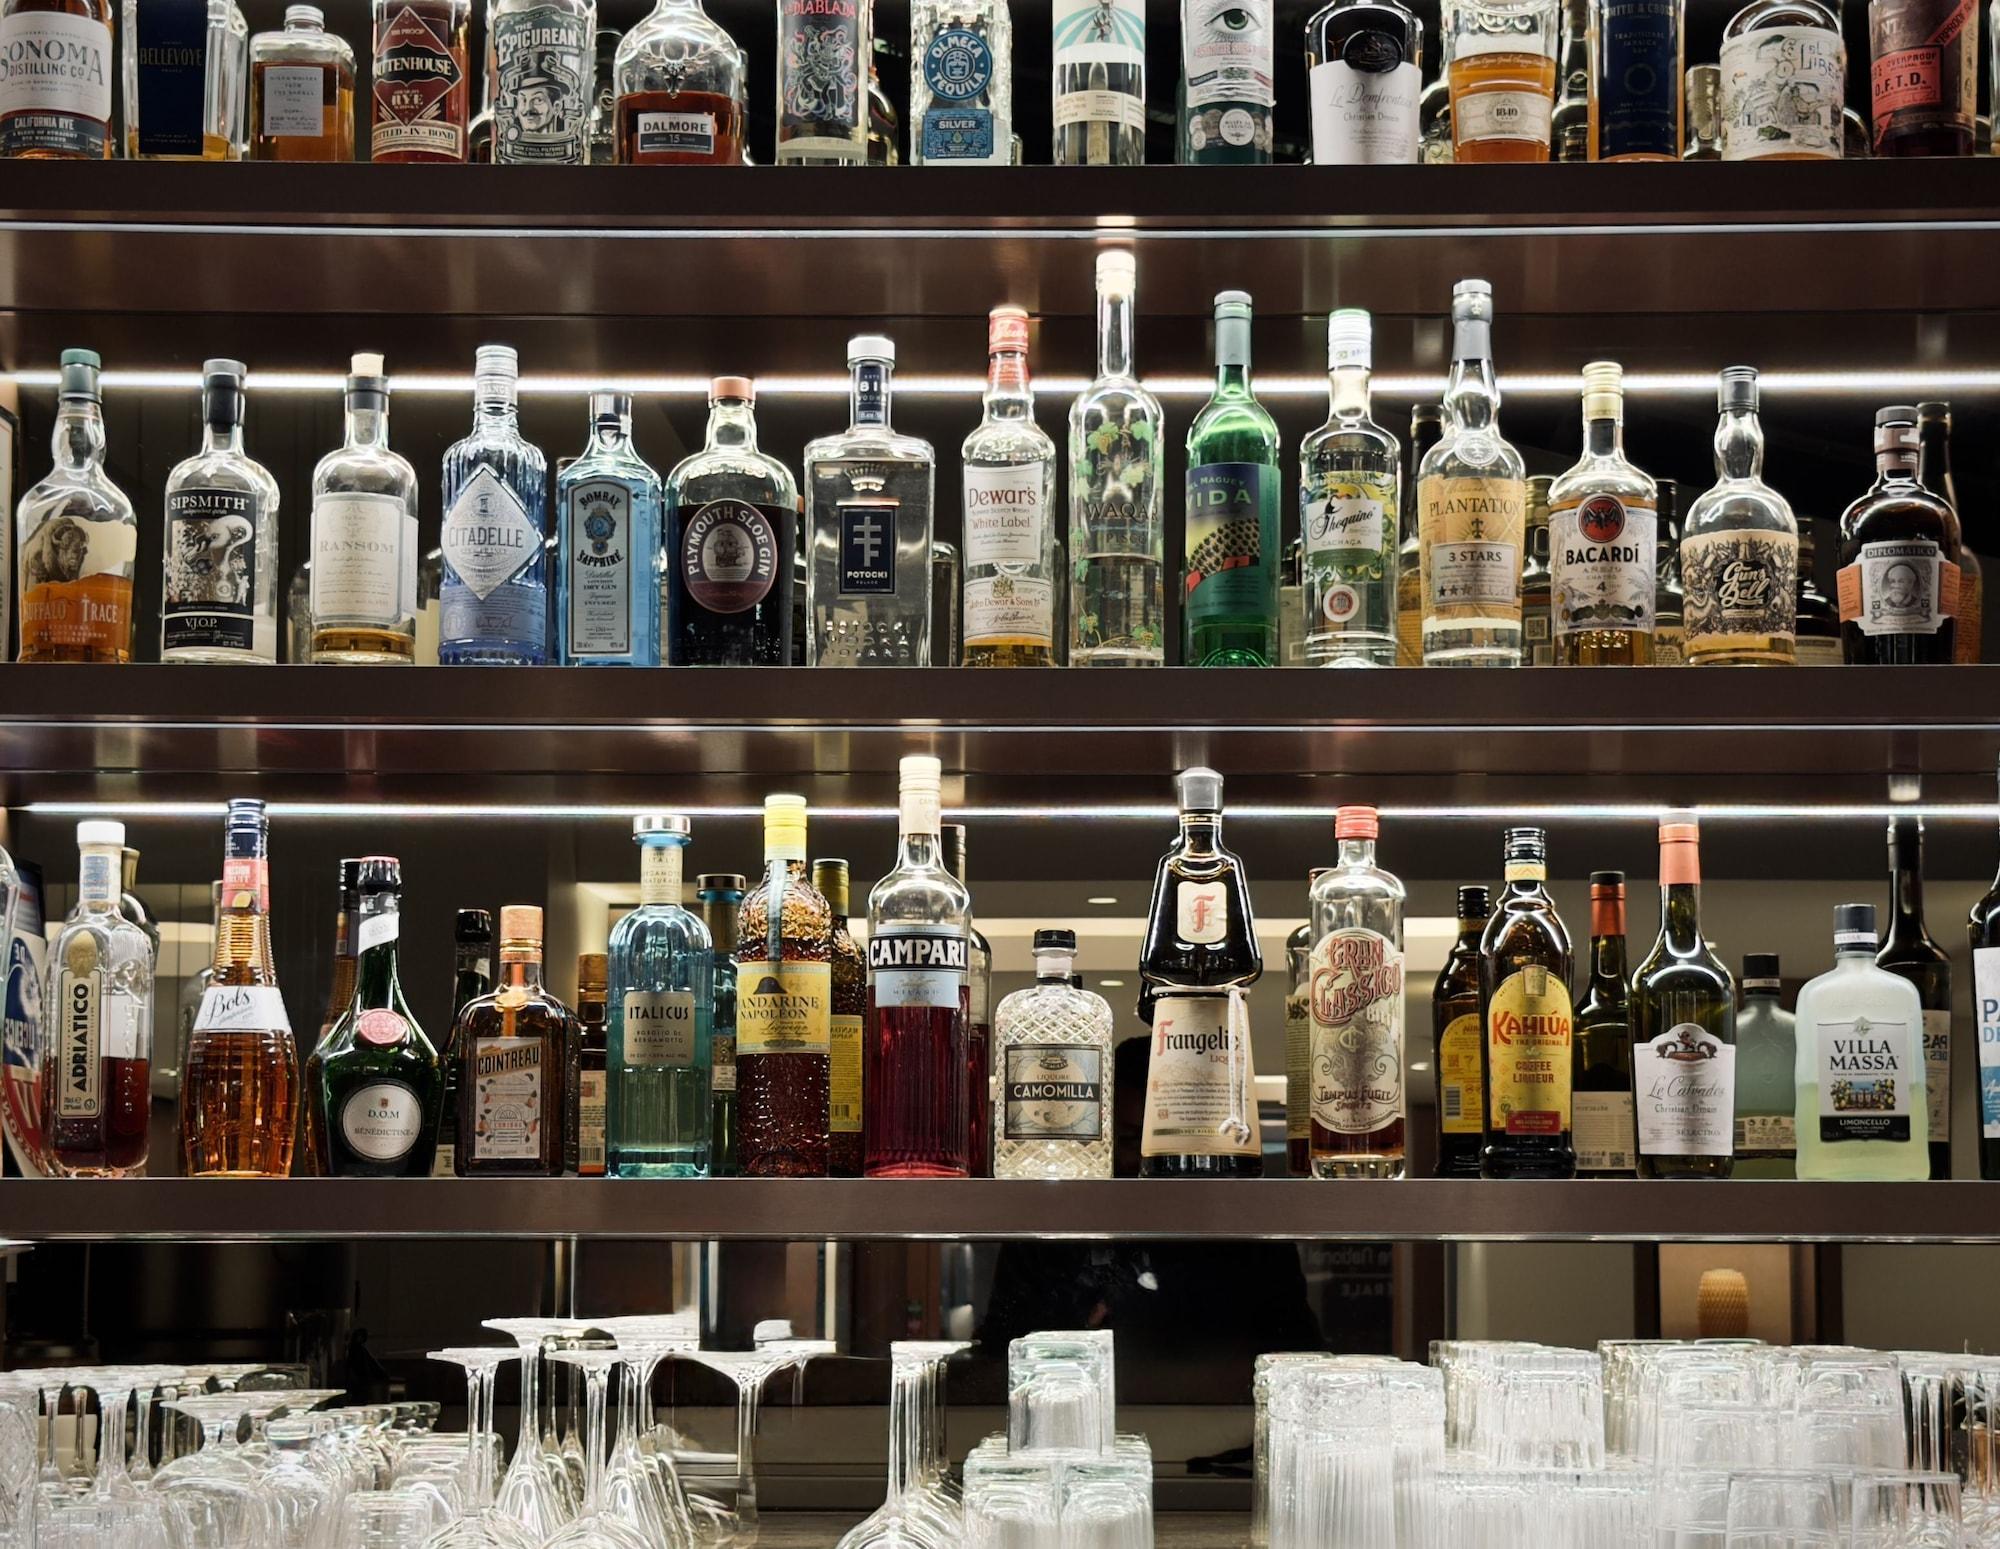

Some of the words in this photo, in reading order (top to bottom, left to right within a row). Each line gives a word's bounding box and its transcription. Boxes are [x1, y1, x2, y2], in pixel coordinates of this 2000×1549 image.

[514, 22, 533, 32] THE
[498, 28, 577, 66] EPICUREAN
[931, 33, 984, 59] OLMECA
[140, 47, 204, 66] BELLEVOYE
[9, 62, 67, 77] DISTILLING
[931, 72, 986, 96] TEQUILA
[391, 94, 424, 106] RYE
[15, 116, 57, 129] CALIFORNIA
[59, 117, 74, 131] RYE
[643, 121, 708, 133] DALMORE
[938, 120, 976, 129] SILVER
[668, 134, 680, 143] 15
[170, 495, 247, 511] SIPSMITH
[579, 490, 621, 512] BOMBAY
[969, 486, 1036, 509] Dewar's
[1186, 489, 1252, 511] VIDA
[1430, 497, 1521, 517] PLANTATION
[1087, 502, 1159, 523] WAQAR
[449, 526, 524, 549] CITADELLE
[687, 506, 734, 576] PLYMOUTH
[737, 510, 769, 545] SLOE
[758, 549, 772, 577] GIN
[1105, 534, 1147, 546] PISCO
[320, 540, 394, 555] RANSOM
[1449, 551, 1457, 562] 3
[1460, 550, 1502, 562] STARS
[1566, 544, 1640, 566] BACARDÍ
[576, 549, 625, 568] SAPPHIRE
[846, 571, 888, 579] POTOCKI
[1596, 581, 1606, 592] 4
[1718, 578, 1770, 608] Bell
[82, 594, 119, 623] TRACE
[870, 939, 966, 967] CAMPARI
[1326, 938, 1384, 971] GRAN
[1311, 963, 1401, 1026] CLASSICO
[205, 985, 252, 1025] Bols
[630, 1006, 689, 1020] ITALICUS
[72, 983, 89, 1092] ADRIATICO
[1492, 1010, 1570, 1046] KAHLÚA
[1834, 1040, 1892, 1054] VILLA
[477, 1047, 540, 1075] COINTREAU
[1515, 1061, 1552, 1071] COFFEE
[1830, 1056, 1898, 1070] MASSA
[1513, 1073, 1554, 1083] LIQUEUR
[1667, 1075, 1725, 1098] Calvados
[1013, 1084, 1095, 1099] CAMOMILLA
[1839, 1118, 1890, 1126] LIMONCELLO
